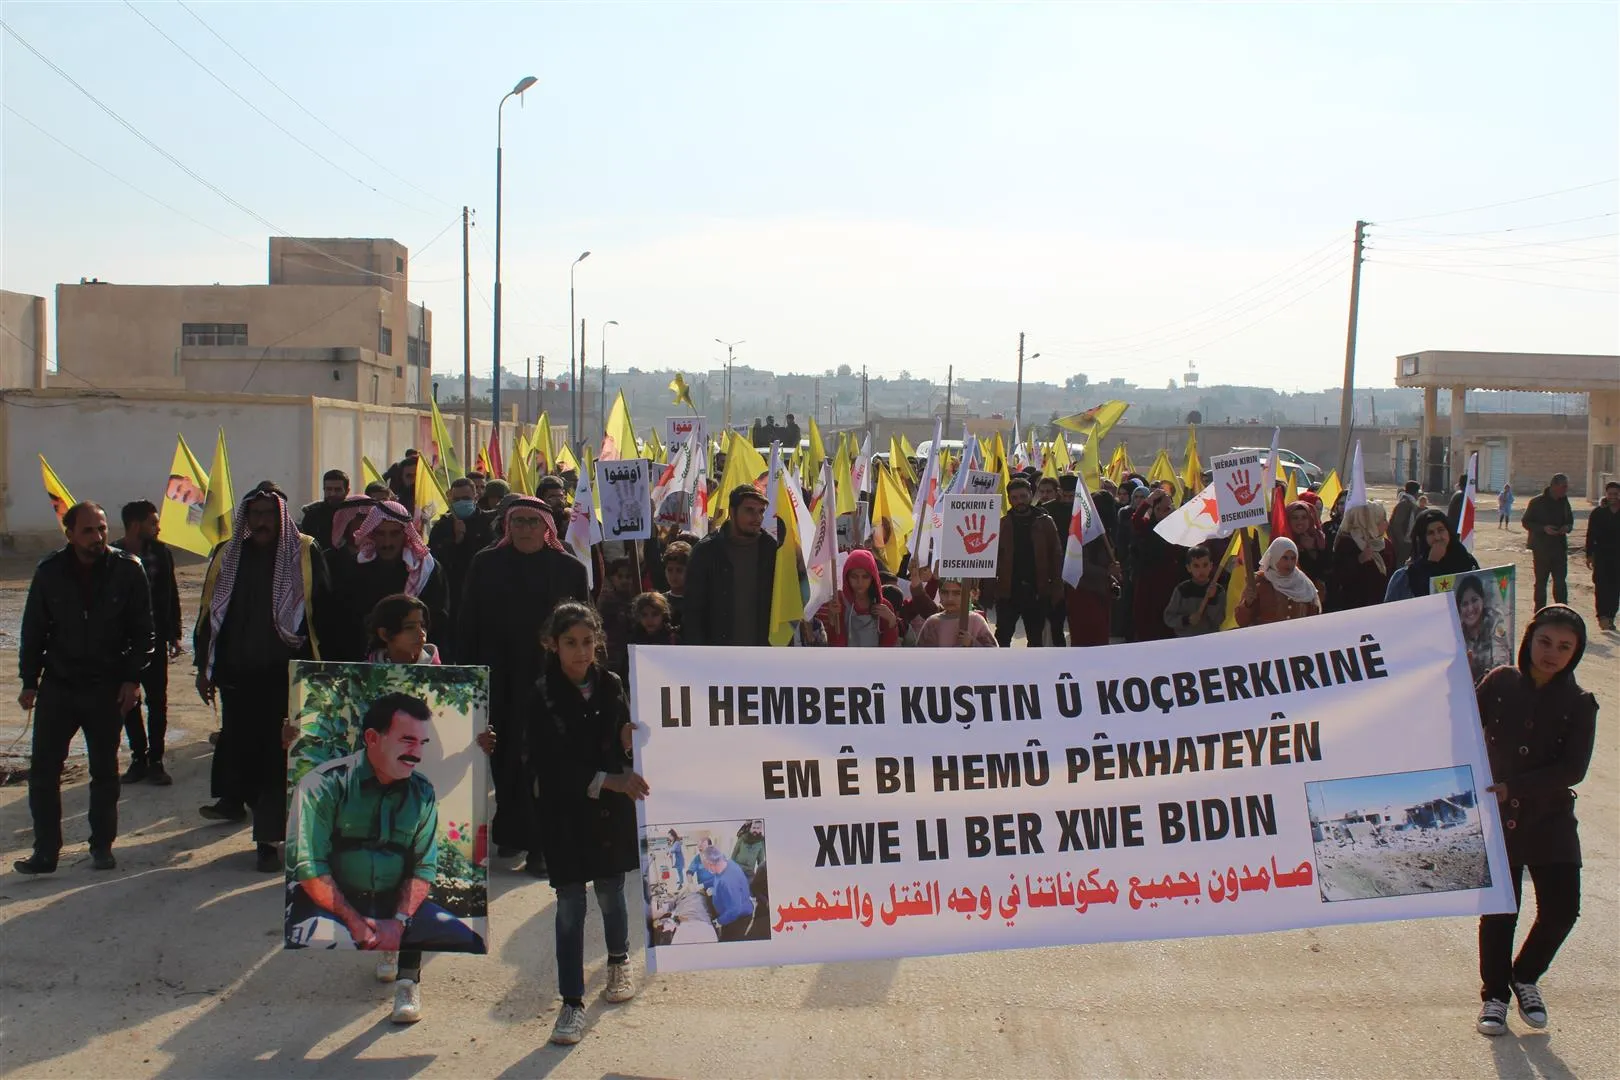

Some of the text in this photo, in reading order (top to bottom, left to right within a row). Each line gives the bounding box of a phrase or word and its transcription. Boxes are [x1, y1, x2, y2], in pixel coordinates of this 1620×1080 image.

[604, 461, 642, 485] أوقفوا
[1214, 455, 1258, 470] WÊRAN KIRIN
[612, 517, 645, 536] القتل
[950, 498, 995, 511] KOÇKIRIN Ê
[660, 633, 1389, 730] LI HEMBERÎ KUŞTIN Û KOÇBERKIRINÊ
[762, 711, 1322, 800] EM Ê BI HEMÛ PÊKHATEYÊN
[813, 793, 1278, 868] XWE LI BER XWE BIDIN
[947, 884, 993, 921] وجه
[998, 873, 1022, 928] في
[1127, 870, 1202, 911] بجميع
[1207, 855, 1314, 904] صامدون
[772, 883, 875, 934] والتهجير
[880, 880, 941, 927] القتل
